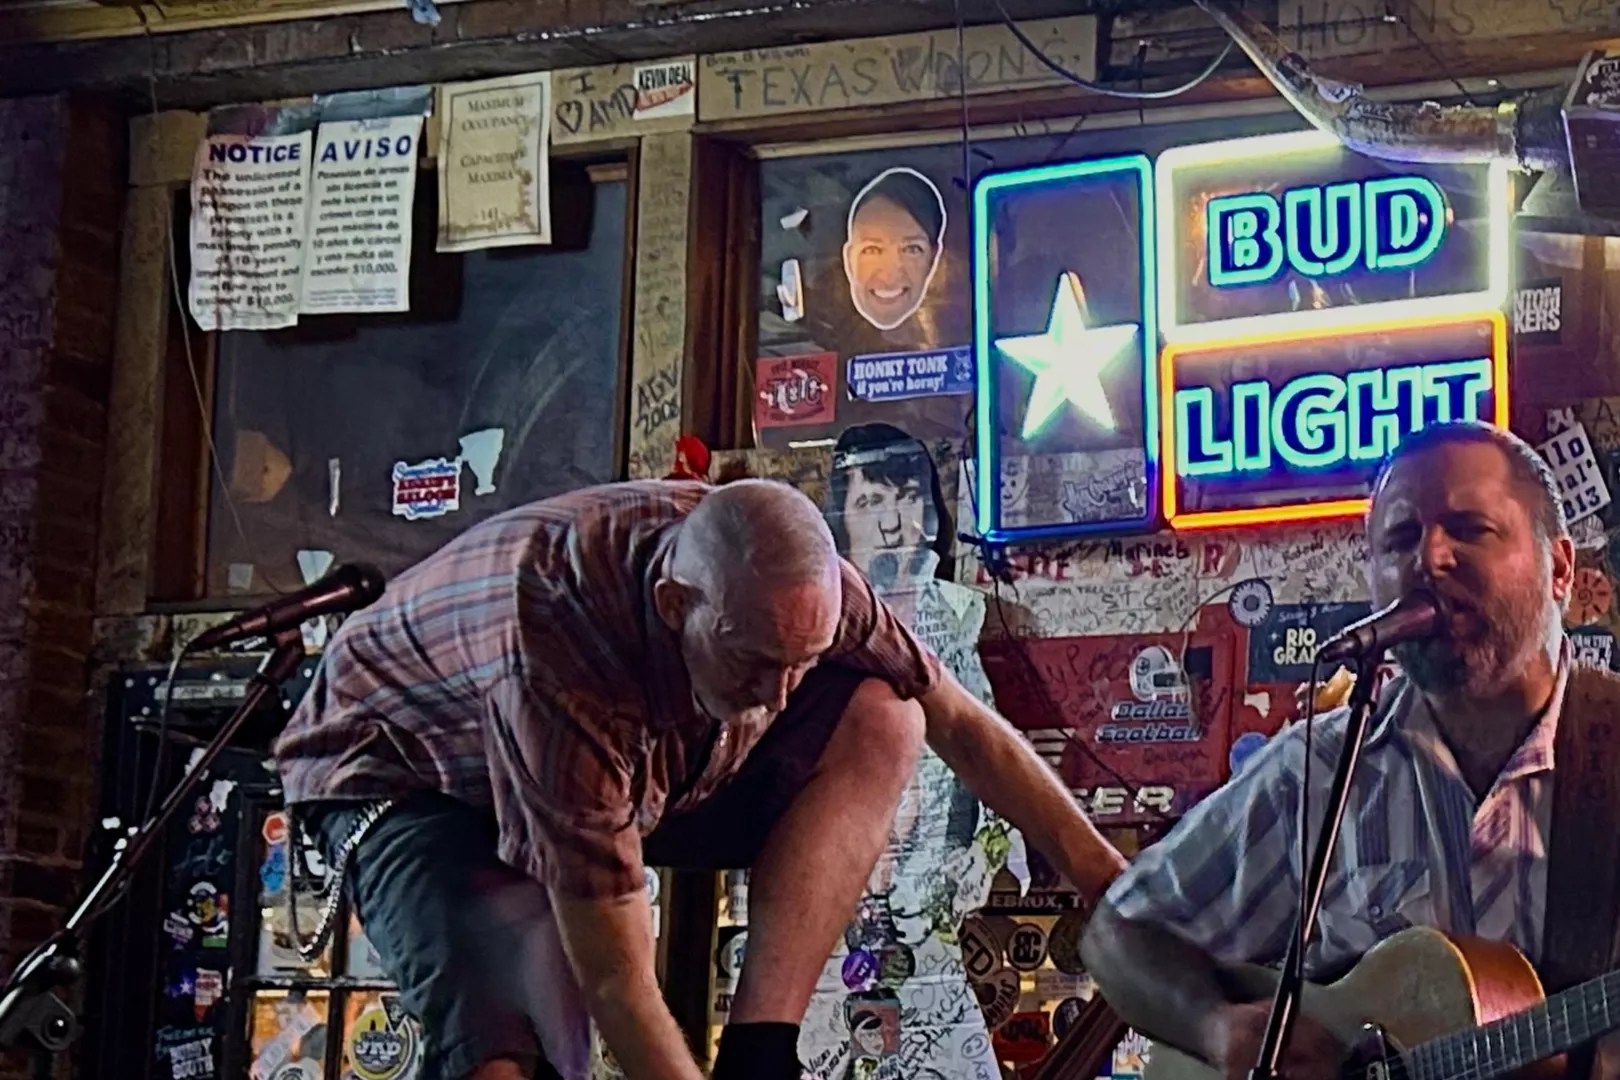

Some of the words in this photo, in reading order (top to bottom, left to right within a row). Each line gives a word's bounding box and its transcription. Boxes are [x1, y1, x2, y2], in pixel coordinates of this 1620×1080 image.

[639, 67, 667, 90] KEVIN
[716, 57, 878, 111] TEXAS
[209, 143, 301, 163] NOTICE
[321, 135, 412, 162] AVISO
[203, 168, 231, 181] The
[235, 168, 301, 181] unlicensed
[364, 167, 376, 176] de
[379, 166, 409, 175] armas
[278, 182, 291, 193] of
[326, 184, 341, 192] sin
[343, 181, 382, 191] licencia
[385, 180, 398, 188] en
[321, 197, 342, 206] este
[344, 194, 368, 204] local
[386, 193, 399, 201] un
[320, 211, 352, 220] crimen
[355, 210, 375, 218] con
[378, 208, 397, 216] una
[386, 220, 399, 230] de
[1207, 175, 1449, 286] BUD
[257, 226, 282, 237] with
[263, 239, 302, 251] penalty
[352, 236, 364, 245] de
[345, 250, 375, 260] multa
[378, 250, 393, 259] sin
[254, 256, 286, 267] years
[282, 266, 300, 276] and
[310, 267, 349, 277] exceder
[251, 283, 272, 292] not
[275, 282, 287, 290] to
[854, 360, 905, 380] HONKY
[907, 355, 948, 375] TONK
[906, 375, 945, 393] horny!
[1175, 358, 1493, 477] LIGHT
[1286, 628, 1316, 647] RIO
[1113, 702, 1189, 720] Dallas
